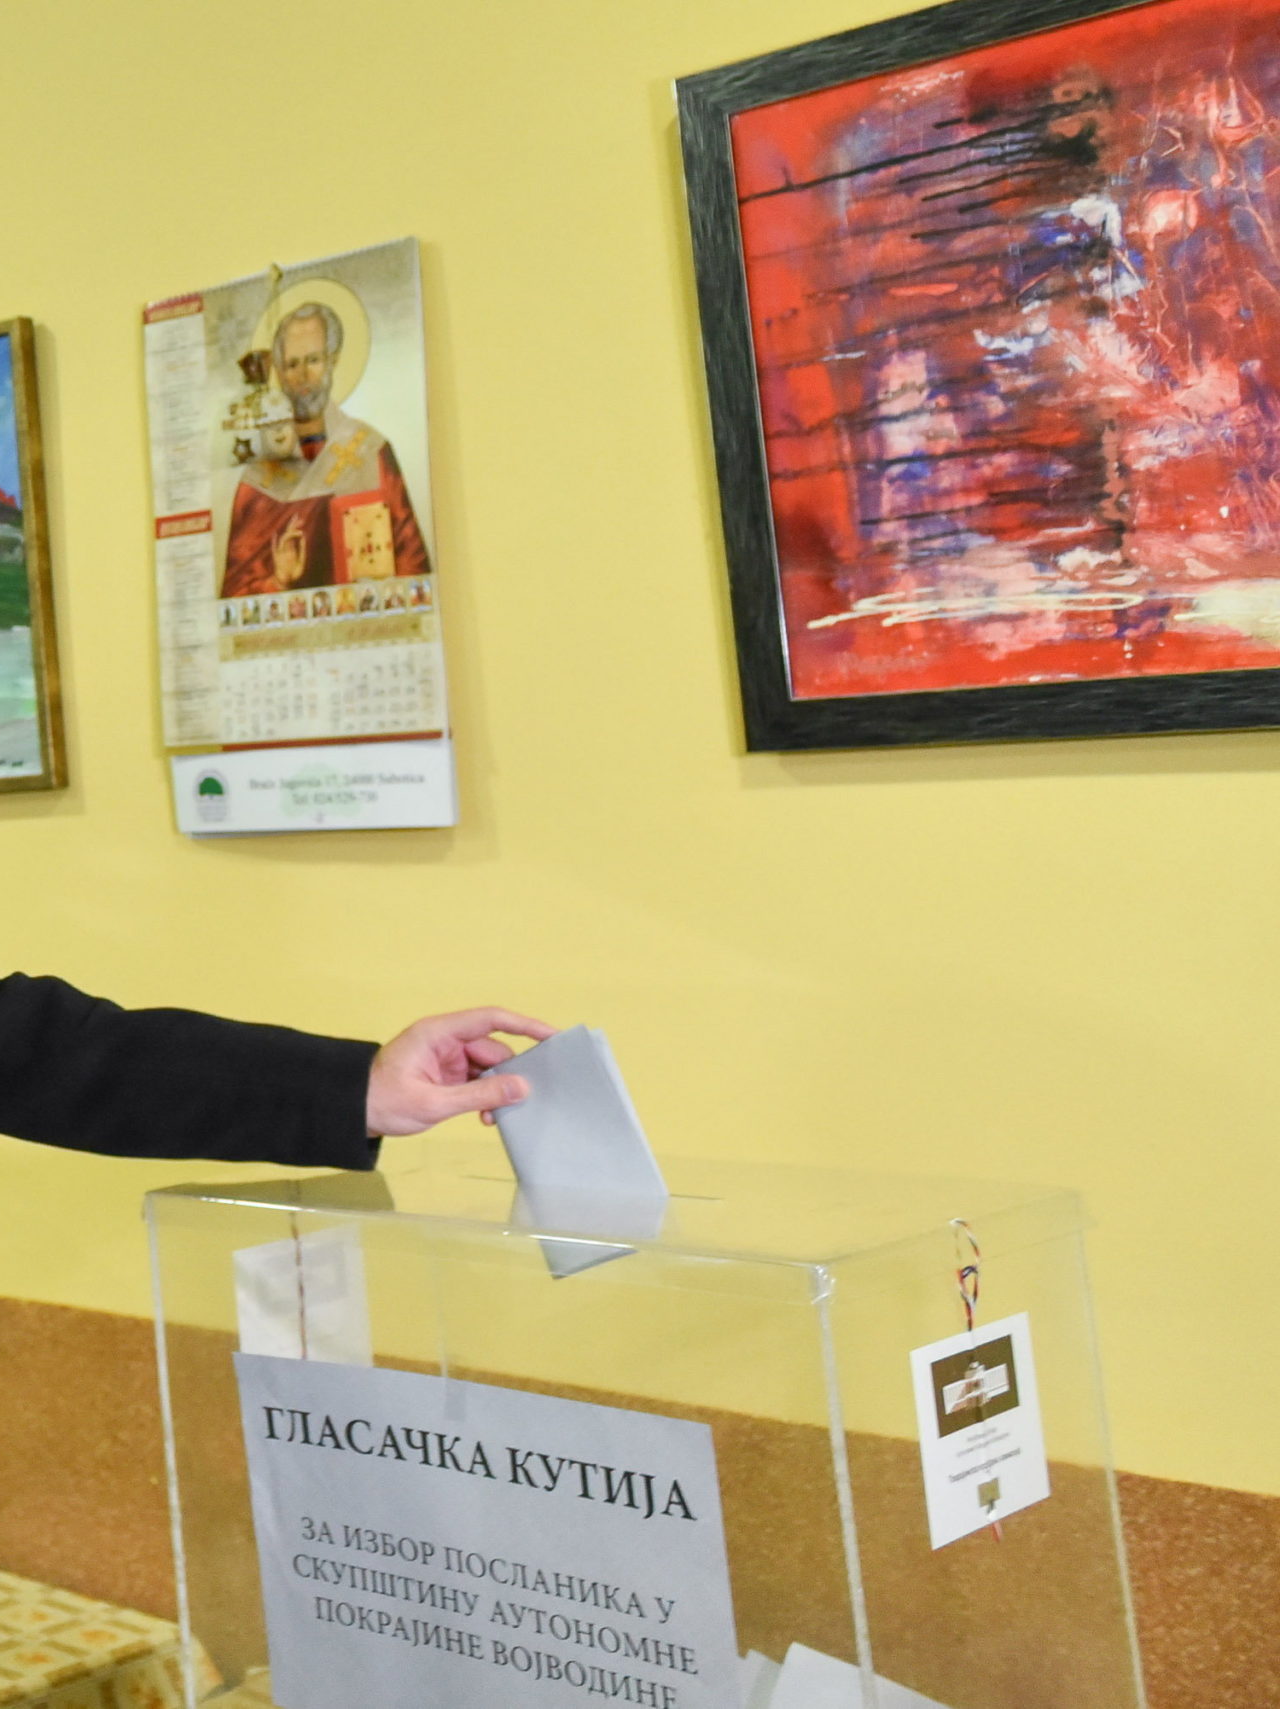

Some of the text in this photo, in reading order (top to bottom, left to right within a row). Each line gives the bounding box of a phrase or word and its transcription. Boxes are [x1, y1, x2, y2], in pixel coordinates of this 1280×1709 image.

[262, 1405, 698, 1522] ГЛАСАЧКА КУТИЈА
[292, 1553, 699, 1676] СКУПШТИНУ АУТОНОМНЕ
[300, 1516, 676, 1624] ЗА ИЗБОР ПОСЛАНИКА У
[314, 1596, 678, 1709] ПОКРАЈИНЕ ВОЈВОДИНЕ
